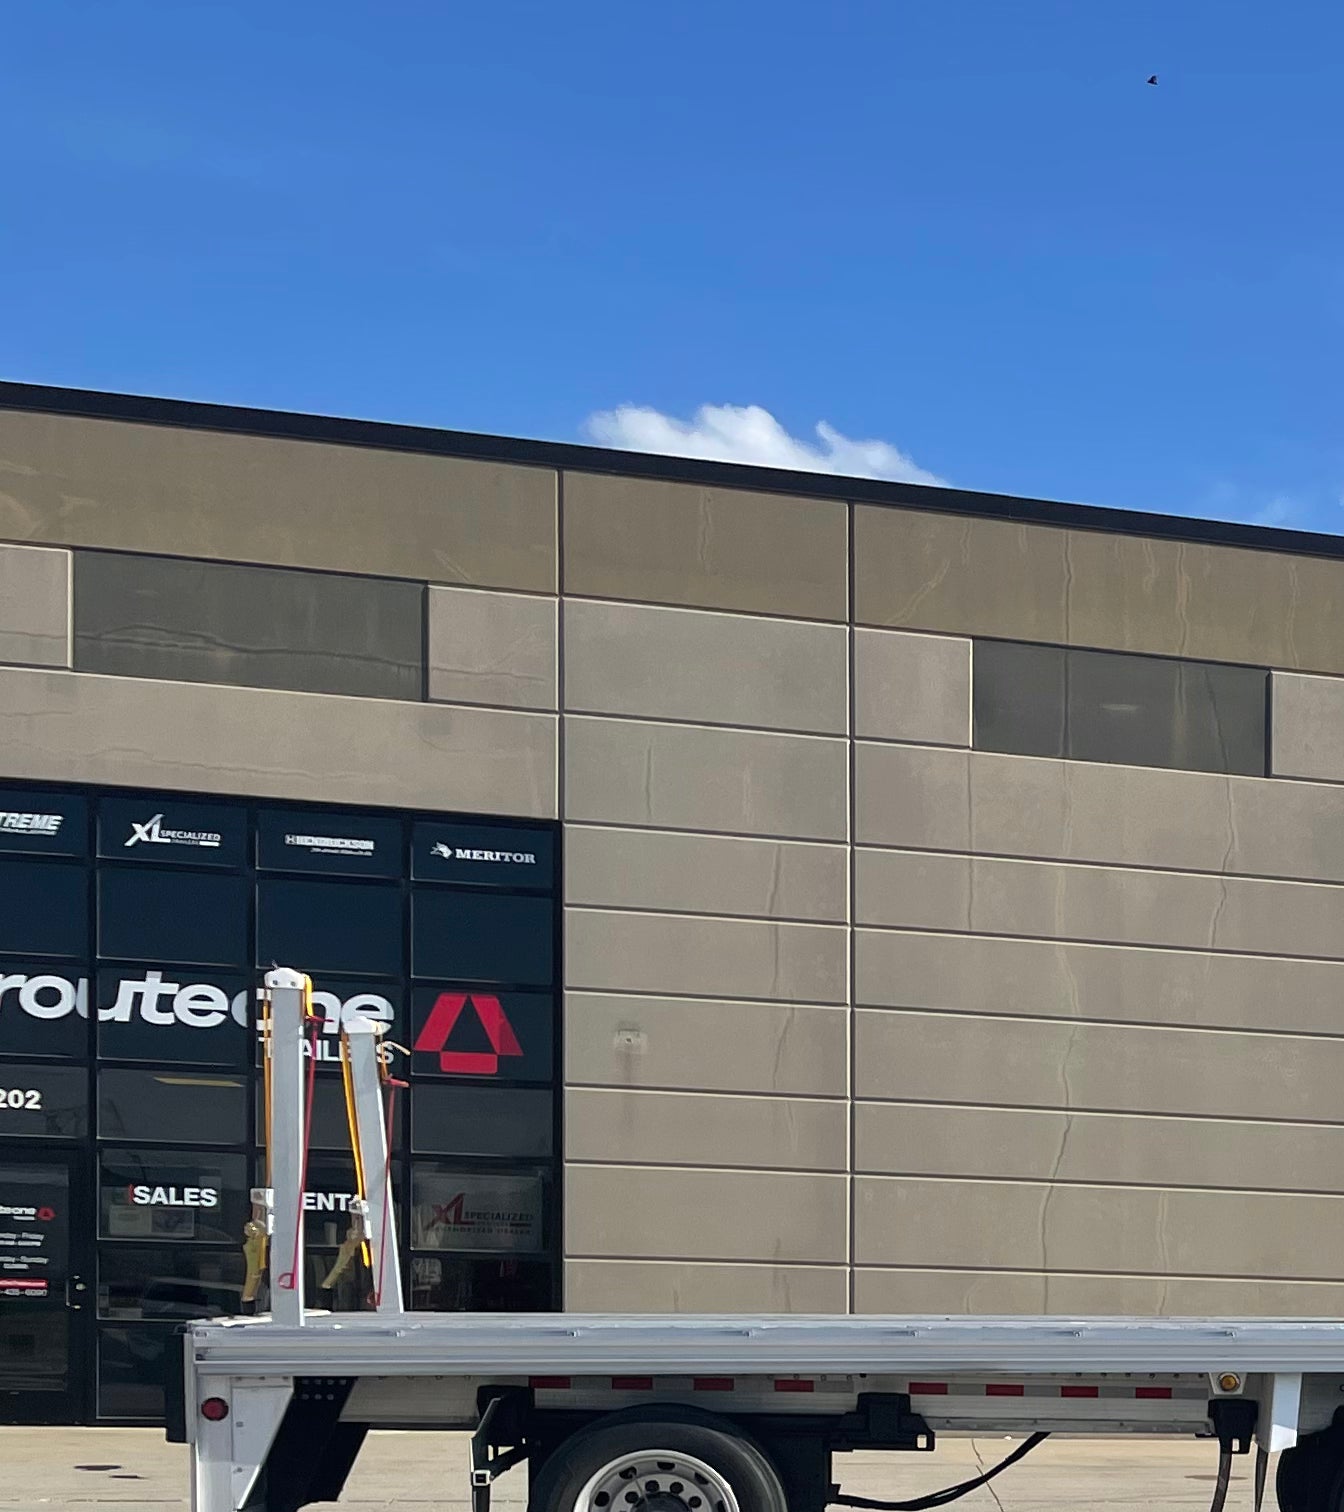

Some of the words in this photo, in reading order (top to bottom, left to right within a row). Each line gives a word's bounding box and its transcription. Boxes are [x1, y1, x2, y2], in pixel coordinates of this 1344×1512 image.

[124, 814, 170, 846] XL
[160, 829, 221, 841] SPECIALIZED
[455, 848, 536, 864] MERITOR
[133, 1185, 217, 1207] SALES
